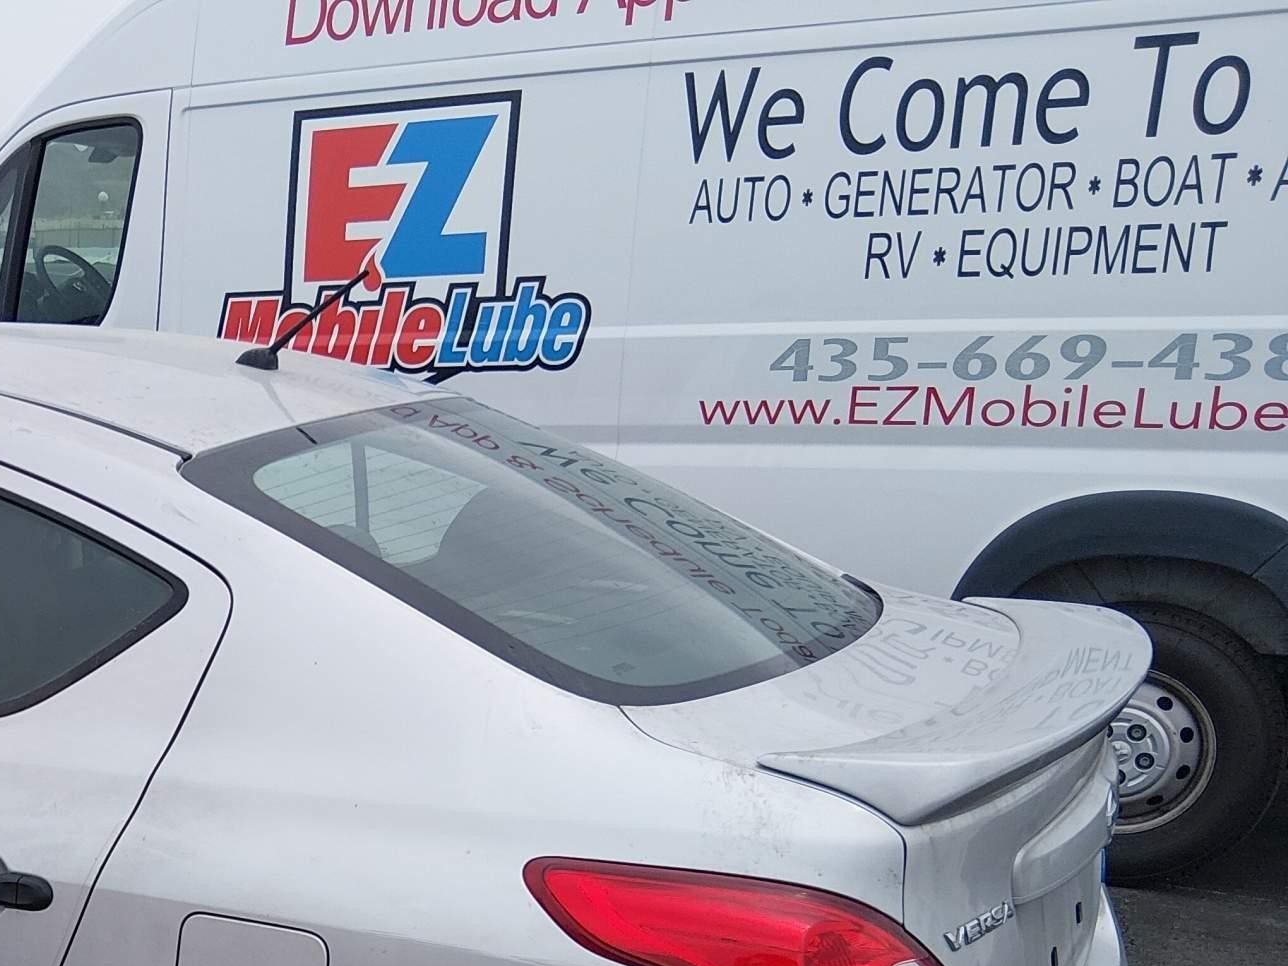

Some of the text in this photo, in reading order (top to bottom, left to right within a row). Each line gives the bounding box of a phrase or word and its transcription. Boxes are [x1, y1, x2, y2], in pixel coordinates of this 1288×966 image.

[684, 31, 1250, 164] We Come To
[304, 113, 500, 283] EZ
[689, 174, 791, 224] AUTO
[824, 161, 1077, 219] GENERATOR
[1112, 152, 1238, 208] BOAT
[864, 221, 1229, 279] RV EQUIPMENT
[699, 384, 1288, 431] www.EZMobileLube
[943, 901, 1014, 952] VERSA
